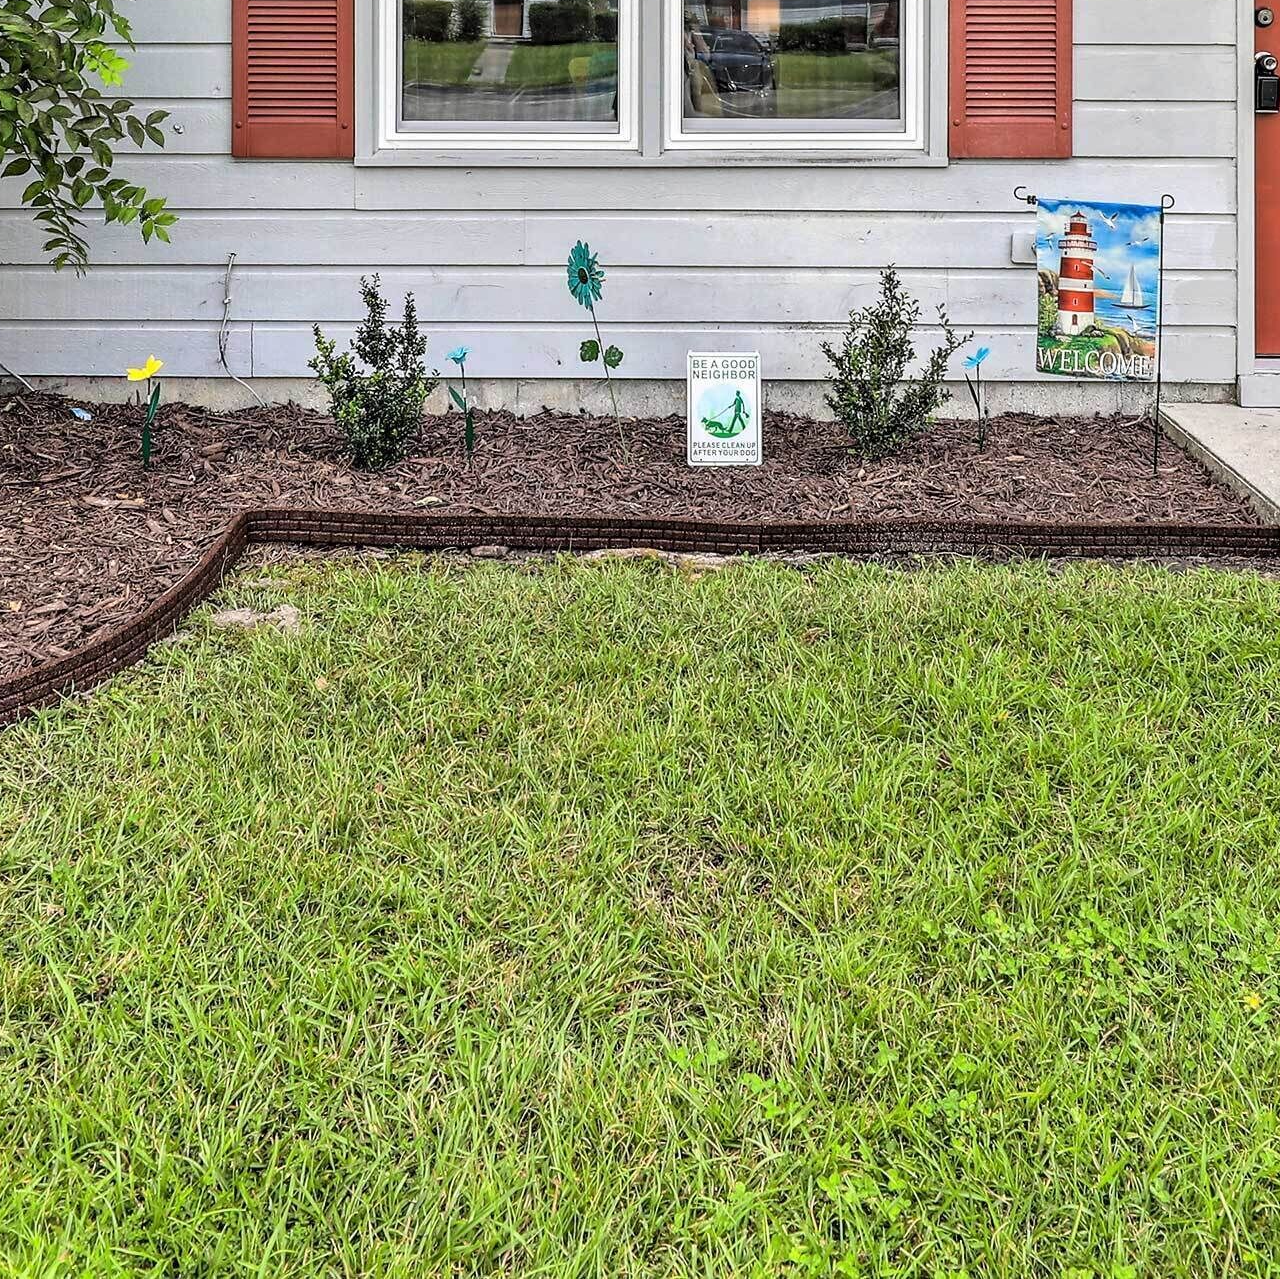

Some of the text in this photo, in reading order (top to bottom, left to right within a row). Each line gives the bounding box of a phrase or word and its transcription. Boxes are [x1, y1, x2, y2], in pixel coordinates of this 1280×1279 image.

[693, 359, 755, 369] BE A GOOD
[1037, 347, 1153, 377] WELCOME
[692, 370, 756, 379] NEIGHBOR
